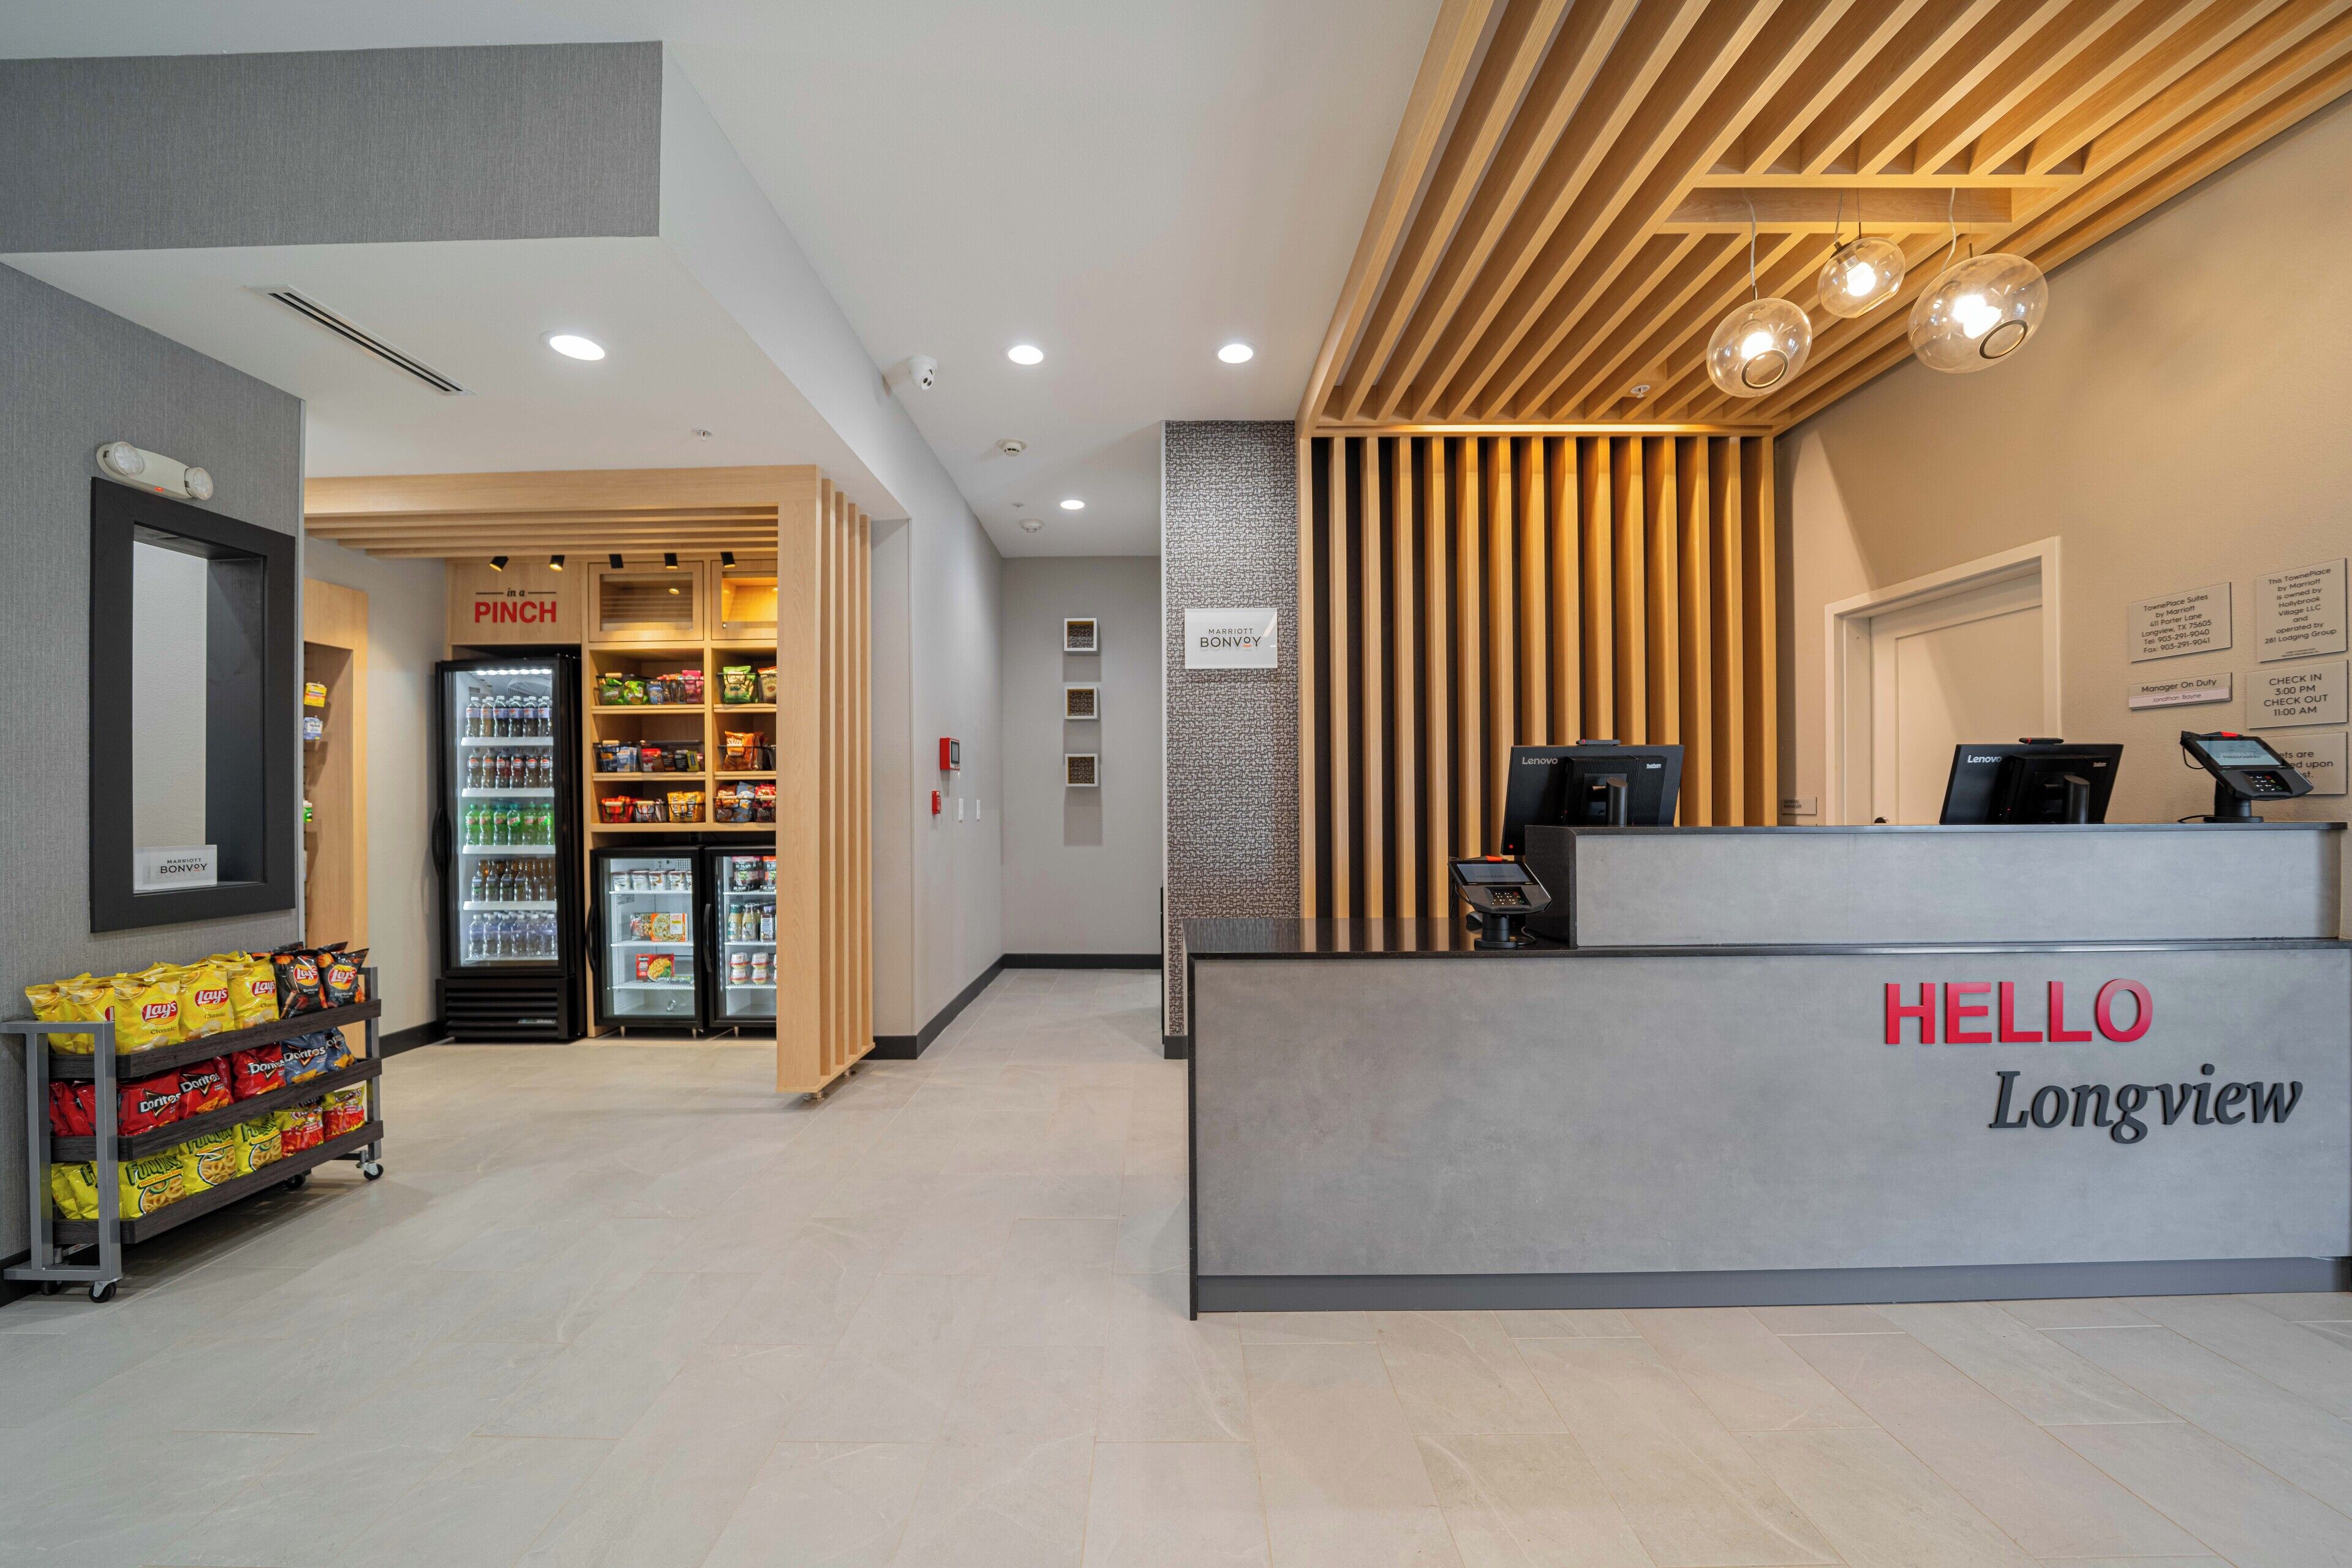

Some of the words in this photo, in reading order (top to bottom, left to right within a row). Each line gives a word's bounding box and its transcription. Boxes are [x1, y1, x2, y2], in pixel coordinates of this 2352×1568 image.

[2284, 568, 2331, 582] TownePlace
[2290, 578, 2321, 589] Marriott
[507, 587, 516, 597] in
[2284, 589, 2310, 598] owned
[2144, 599, 2185, 611] TownePlace
[2187, 594, 2209, 603] Suites
[2278, 596, 2321, 608] Hollybrook
[474, 601, 557, 623] PINCH
[2166, 605, 2195, 616] Marriott
[2278, 608, 2304, 617] Village
[2306, 604, 2321, 612] LLC
[2161, 617, 2182, 625] Porter
[2141, 627, 2176, 638] Longview,
[2188, 619, 2212, 629] 75605
[2276, 623, 2312, 634] operated
[1200, 636, 1262, 647] BONVOY
[2158, 628, 2210, 643] 903-291-9040
[2278, 632, 2309, 643] Lodging
[2311, 628, 2337, 638] Group
[2160, 638, 2211, 651] 903-291-9041
[2269, 674, 2307, 685] CHECK
[2141, 683, 2178, 693] Manager
[2275, 687, 2296, 695] 3:00
[2264, 696, 2301, 707] CHECK
[2304, 694, 2328, 703] OUT
[2274, 707, 2296, 716] 11:00
[1522, 756, 1559, 765] Lenovo
[1967, 755, 2002, 763] Lenovo
[2305, 760, 2334, 769] upon
[197, 989, 228, 1005] Lay's
[145, 1002, 178, 1020] Lay's
[1885, 978, 2154, 1045] HELLO
[150, 1025, 176, 1035] Classic
[284, 1047, 326, 1062] Doritos
[180, 1073, 221, 1093] Doritos
[140, 1093, 182, 1113] Doritos
[1988, 1063, 2304, 1144] Longview
